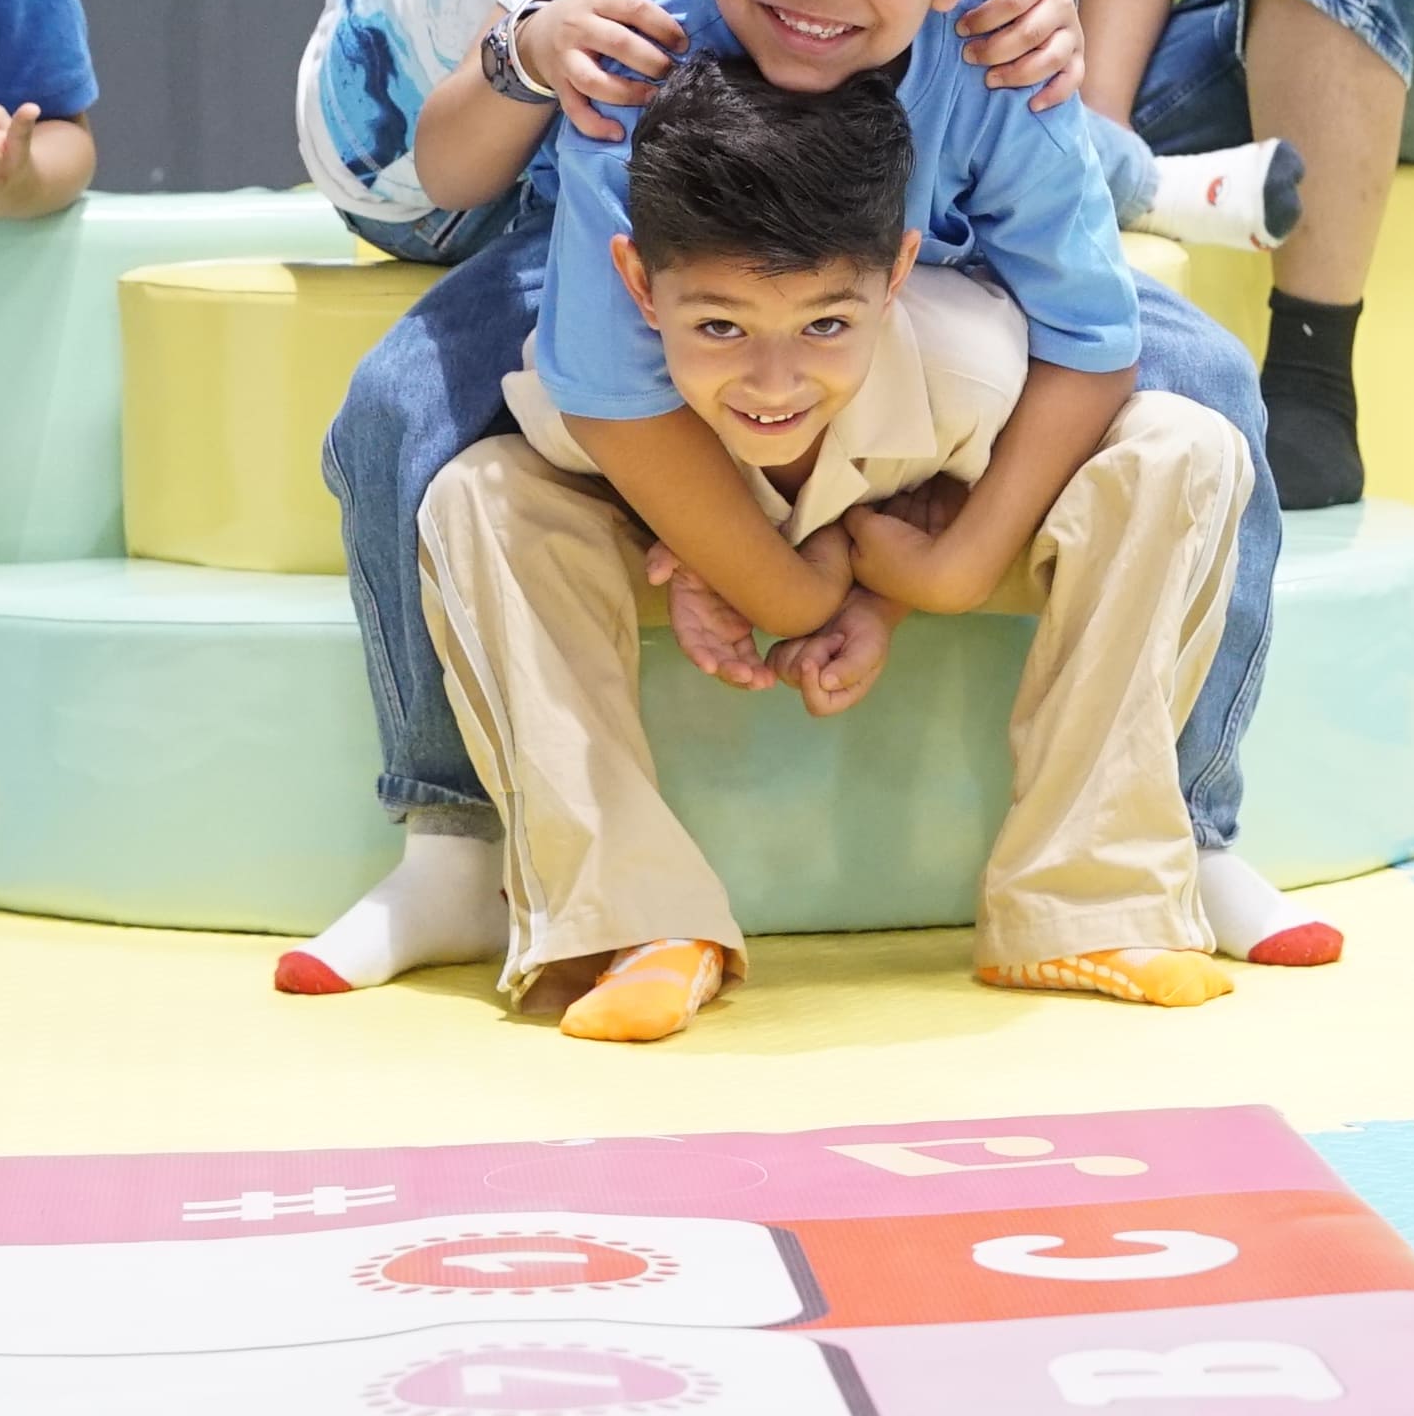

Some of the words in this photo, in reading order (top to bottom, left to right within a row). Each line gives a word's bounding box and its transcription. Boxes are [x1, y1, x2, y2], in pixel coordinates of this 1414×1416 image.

[972, 1230, 1239, 1281] C
[459, 1363, 621, 1396] 7
[1047, 1341, 1345, 1407] B
